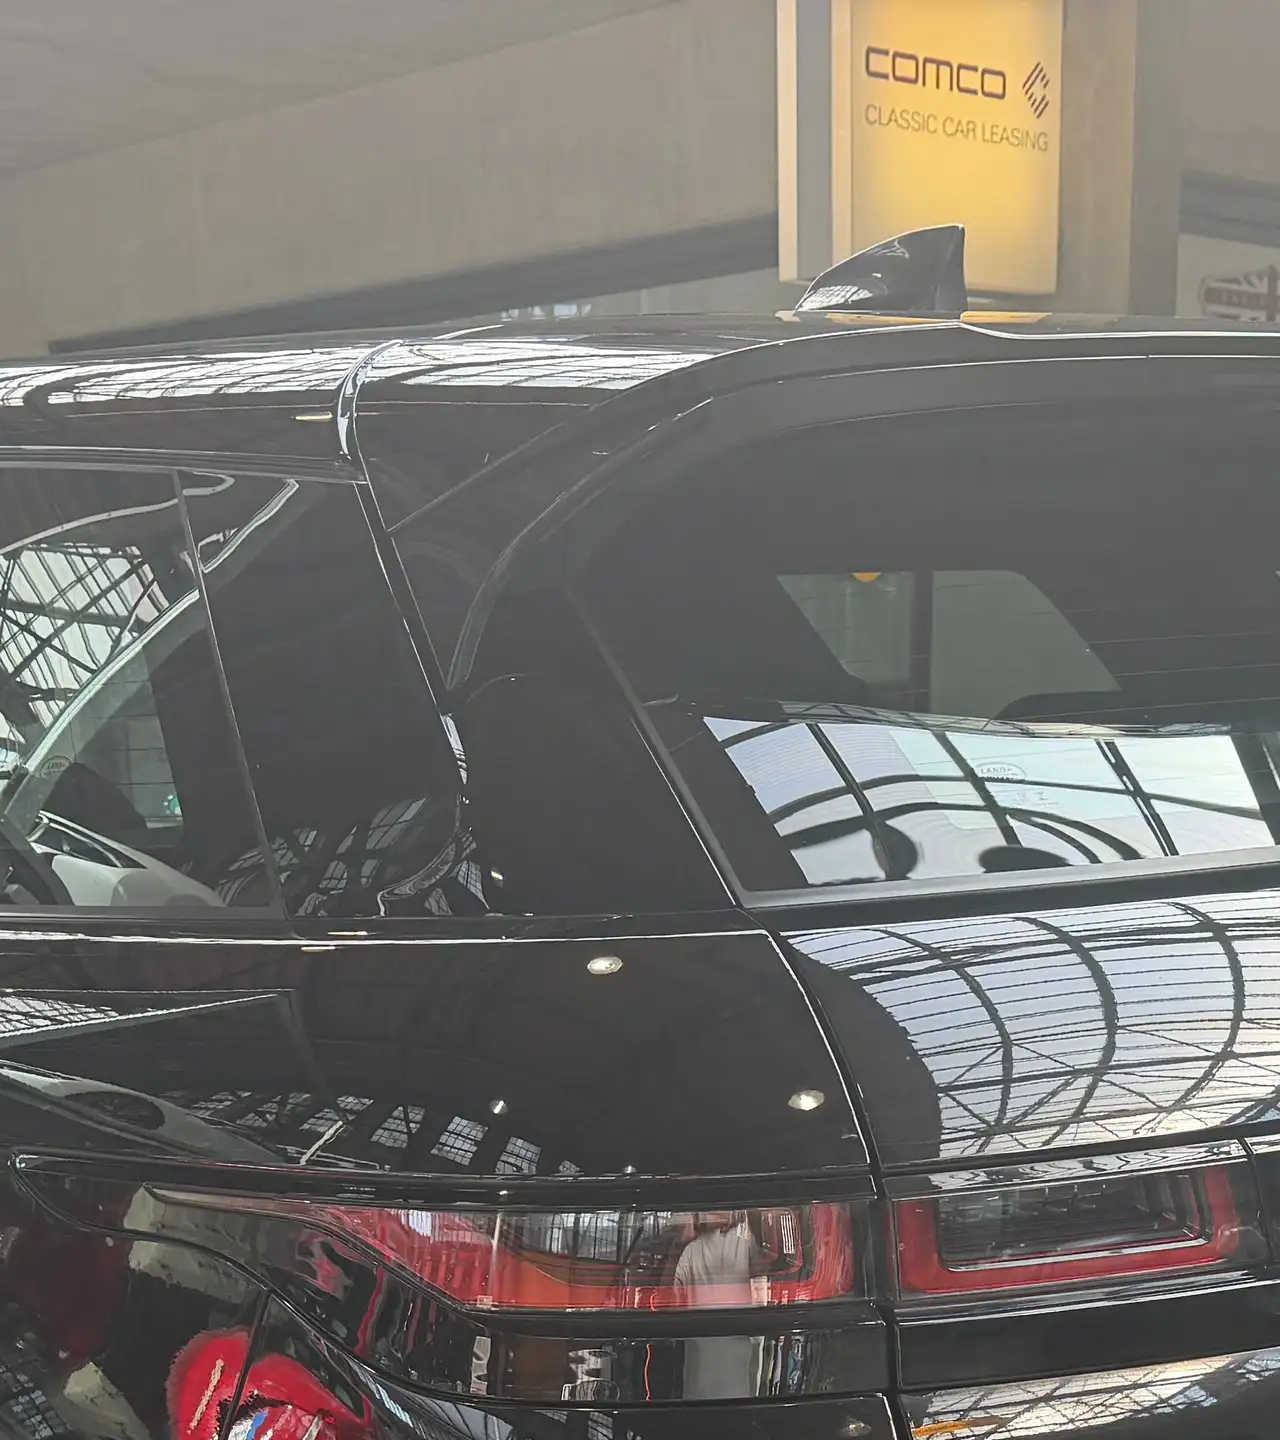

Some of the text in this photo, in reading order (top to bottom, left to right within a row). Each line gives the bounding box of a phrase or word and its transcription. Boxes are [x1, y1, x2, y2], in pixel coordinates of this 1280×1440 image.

[865, 103, 1049, 152] CLASSIC CAR LEASING
